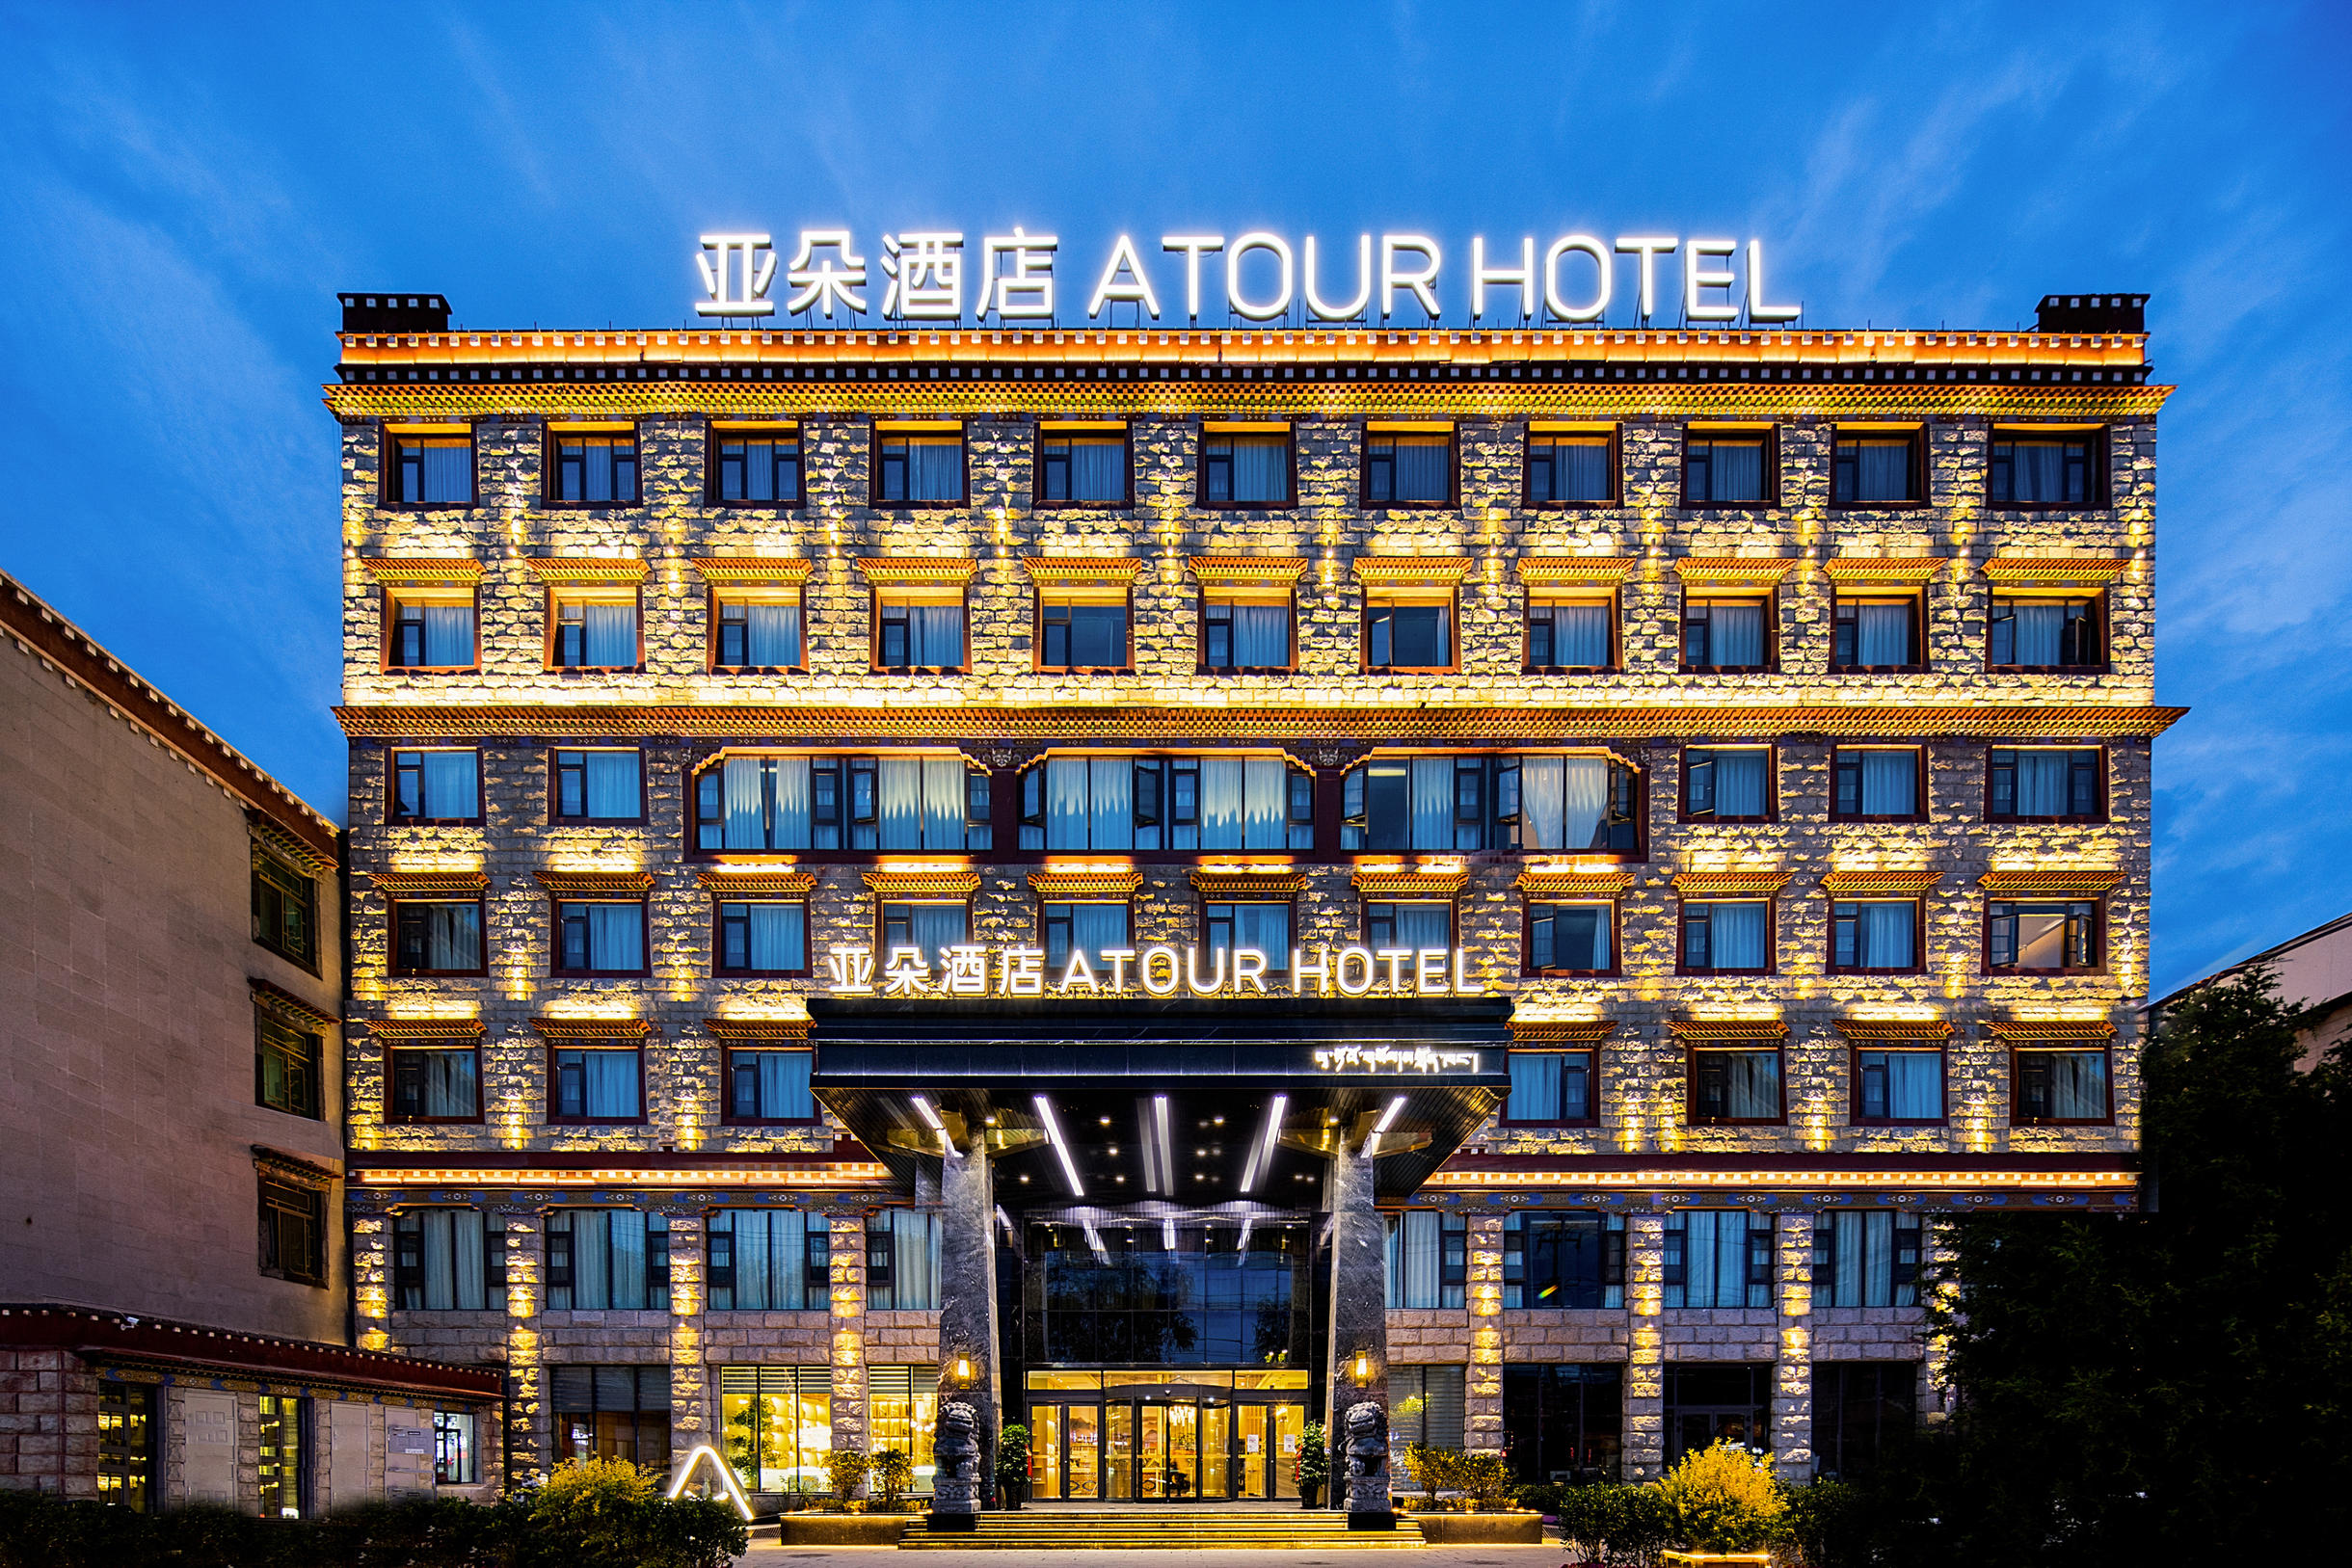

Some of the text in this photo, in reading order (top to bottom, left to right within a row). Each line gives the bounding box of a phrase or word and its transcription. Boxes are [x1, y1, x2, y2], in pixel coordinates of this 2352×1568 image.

[695, 226, 1801, 323] 亚朵酒店 ATOUR HOTEL
[829, 945, 1485, 997] 亚朵酒店 ATOUR HOTEL
